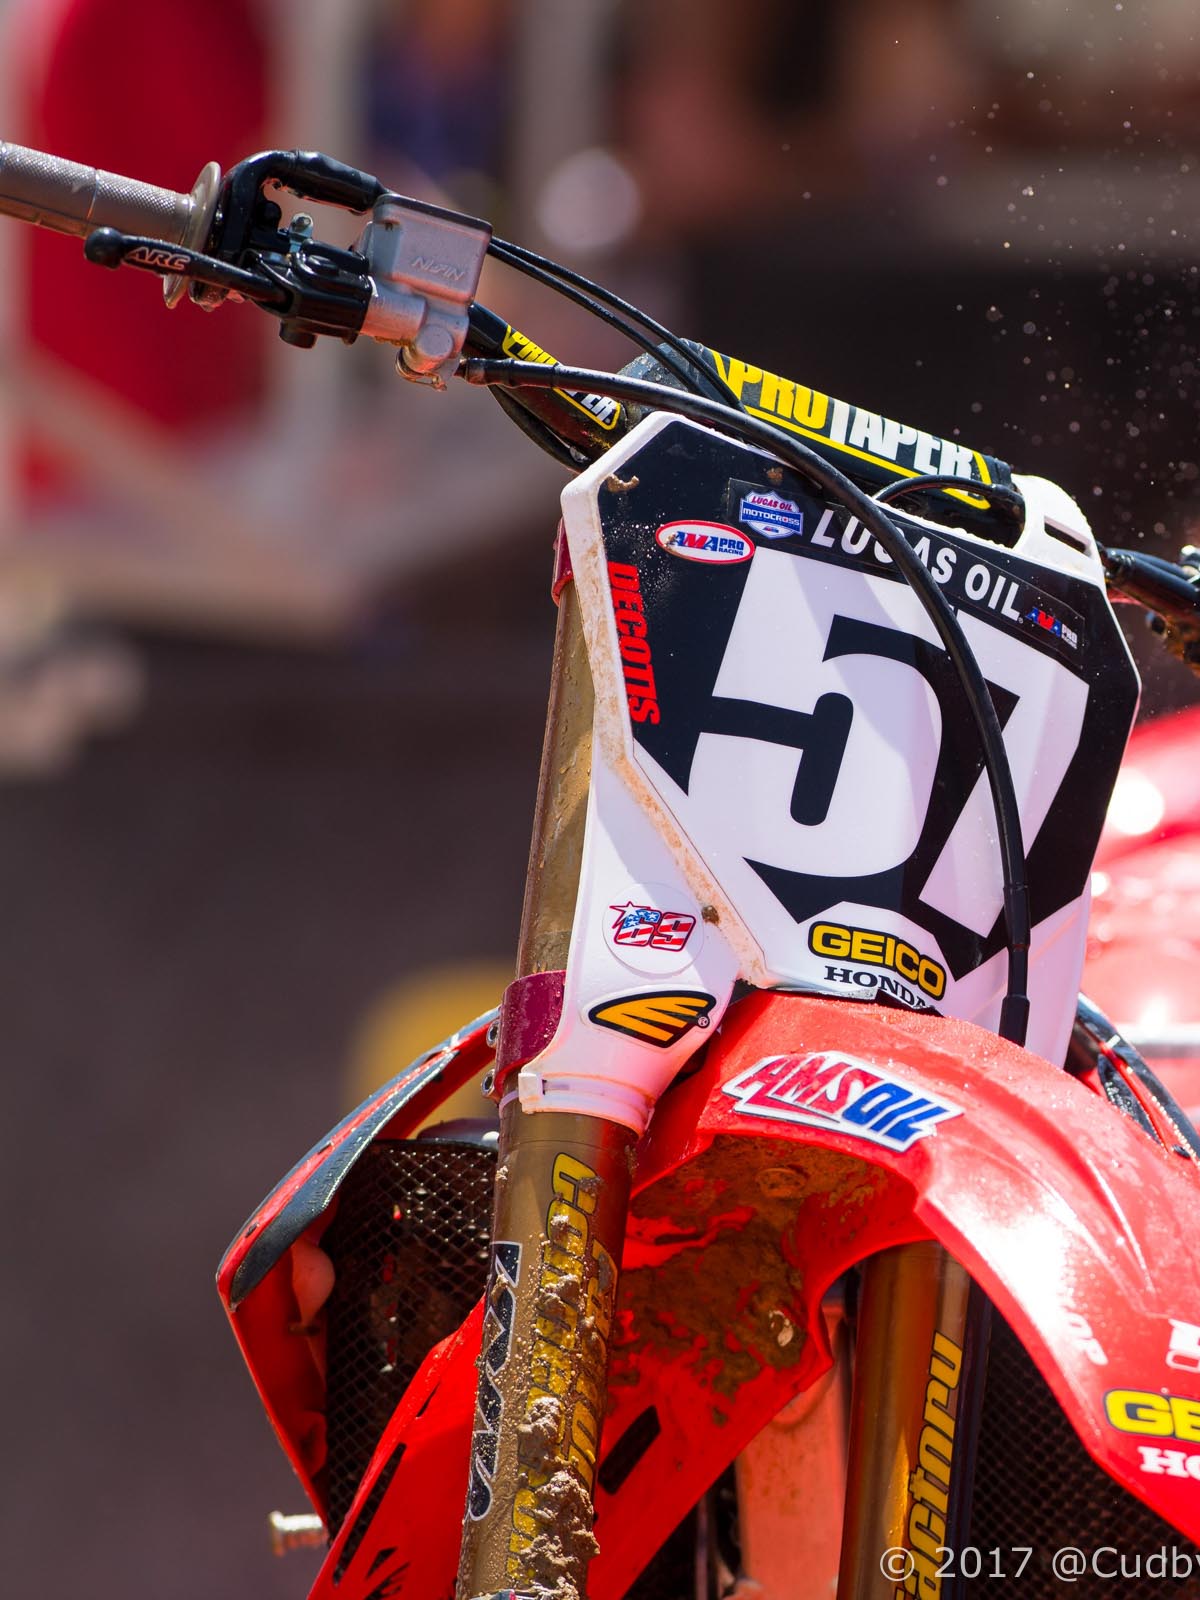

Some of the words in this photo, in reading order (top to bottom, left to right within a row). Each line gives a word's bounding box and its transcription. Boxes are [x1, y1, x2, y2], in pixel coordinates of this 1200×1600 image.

[742, 507, 800, 527] MOTOCROSS
[751, 495, 779, 510] LUCAS
[779, 501, 793, 512] OIL
[718, 537, 745, 551] PRO
[718, 547, 744, 556] RACING
[964, 563, 1020, 622] OIL
[688, 545, 1091, 940] 57
[613, 906, 697, 952] 69
[810, 922, 946, 1000] GEICO
[734, 1055, 950, 1144] AMSOIL
